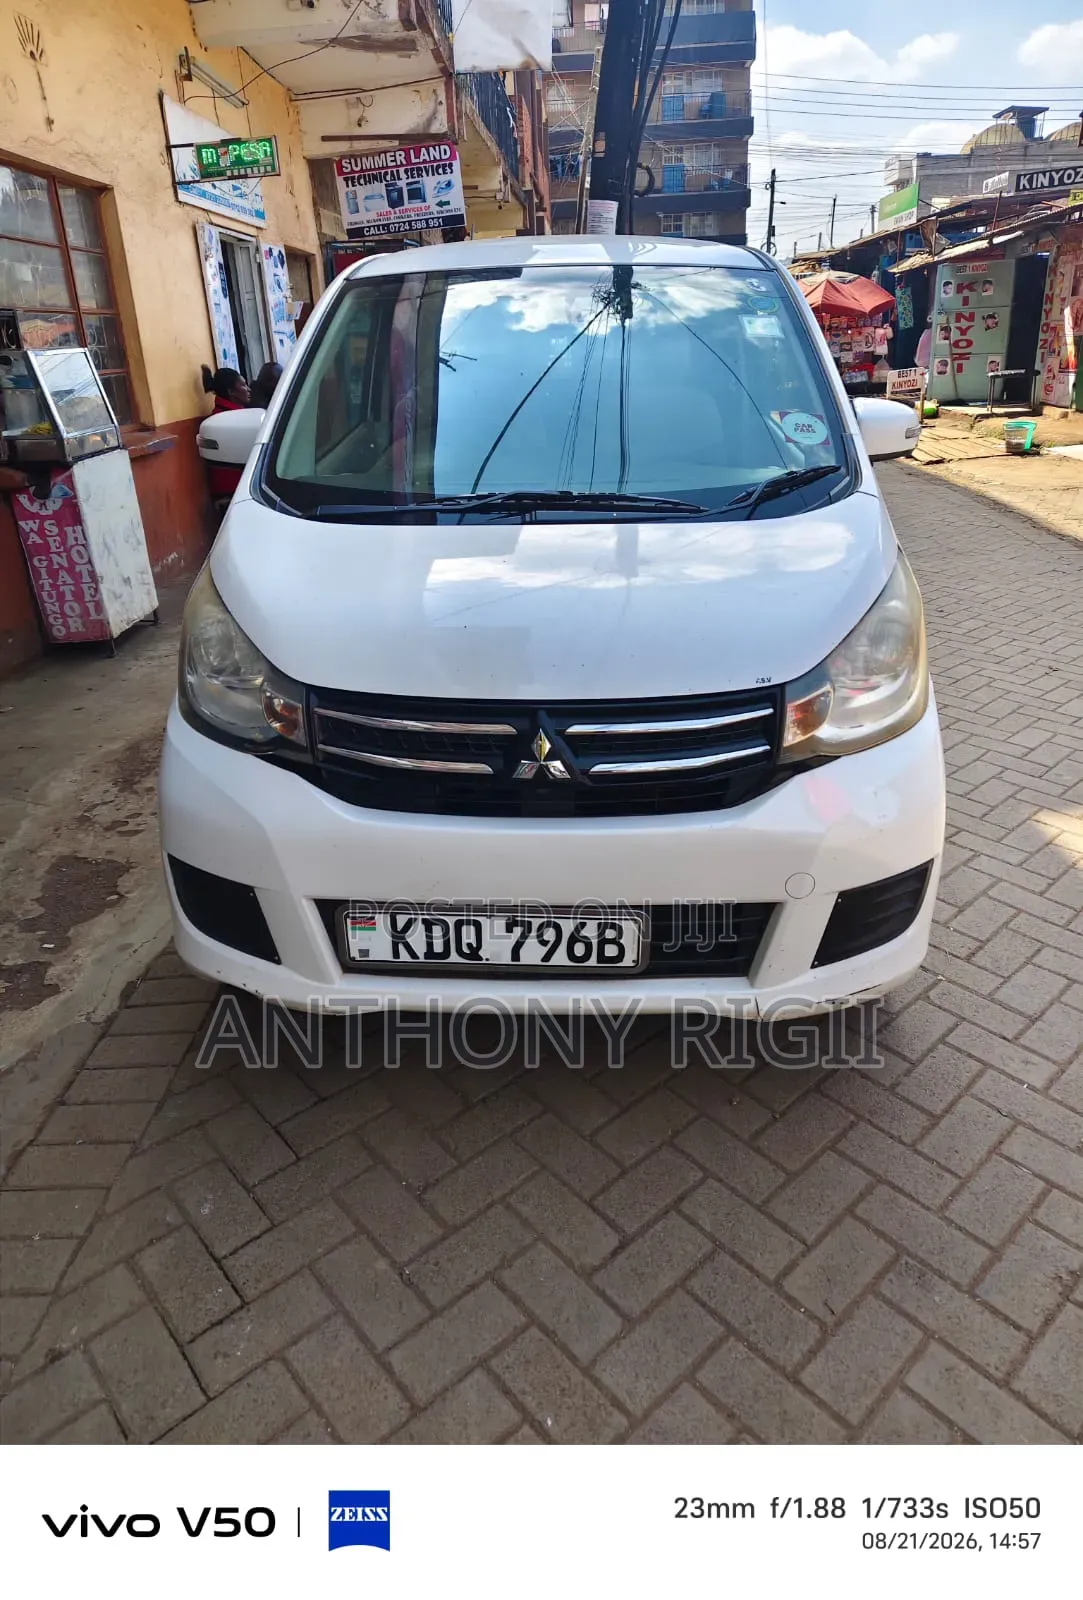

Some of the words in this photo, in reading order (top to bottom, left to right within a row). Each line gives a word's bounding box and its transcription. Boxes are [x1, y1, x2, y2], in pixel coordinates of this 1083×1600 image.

[341, 150, 407, 173] SUMMER
[410, 144, 451, 163] LAND
[343, 168, 402, 188] TECHNICAL
[404, 162, 454, 180] SERVICES
[376, 210, 392, 218] SALES
[398, 206, 423, 215] SERVICES
[423, 204, 431, 212] OF
[364, 226, 388, 236] CALL:
[389, 223, 410, 233] 0724
[411, 220, 428, 229] 588
[428, 218, 444, 227] 951
[956, 265, 968, 274] BEST
[952, 280, 978, 373] KINYOZI
[891, 379, 918, 389] KINYOZI
[897, 370, 911, 379] BEST
[18, 520, 43, 545] WA
[32, 555, 66, 639] GITUNGO
[43, 519, 86, 632] SENATOR
[64, 525, 103, 620] HOTEL
[389, 912, 485, 961] KDQ
[504, 914, 626, 965] 796B
